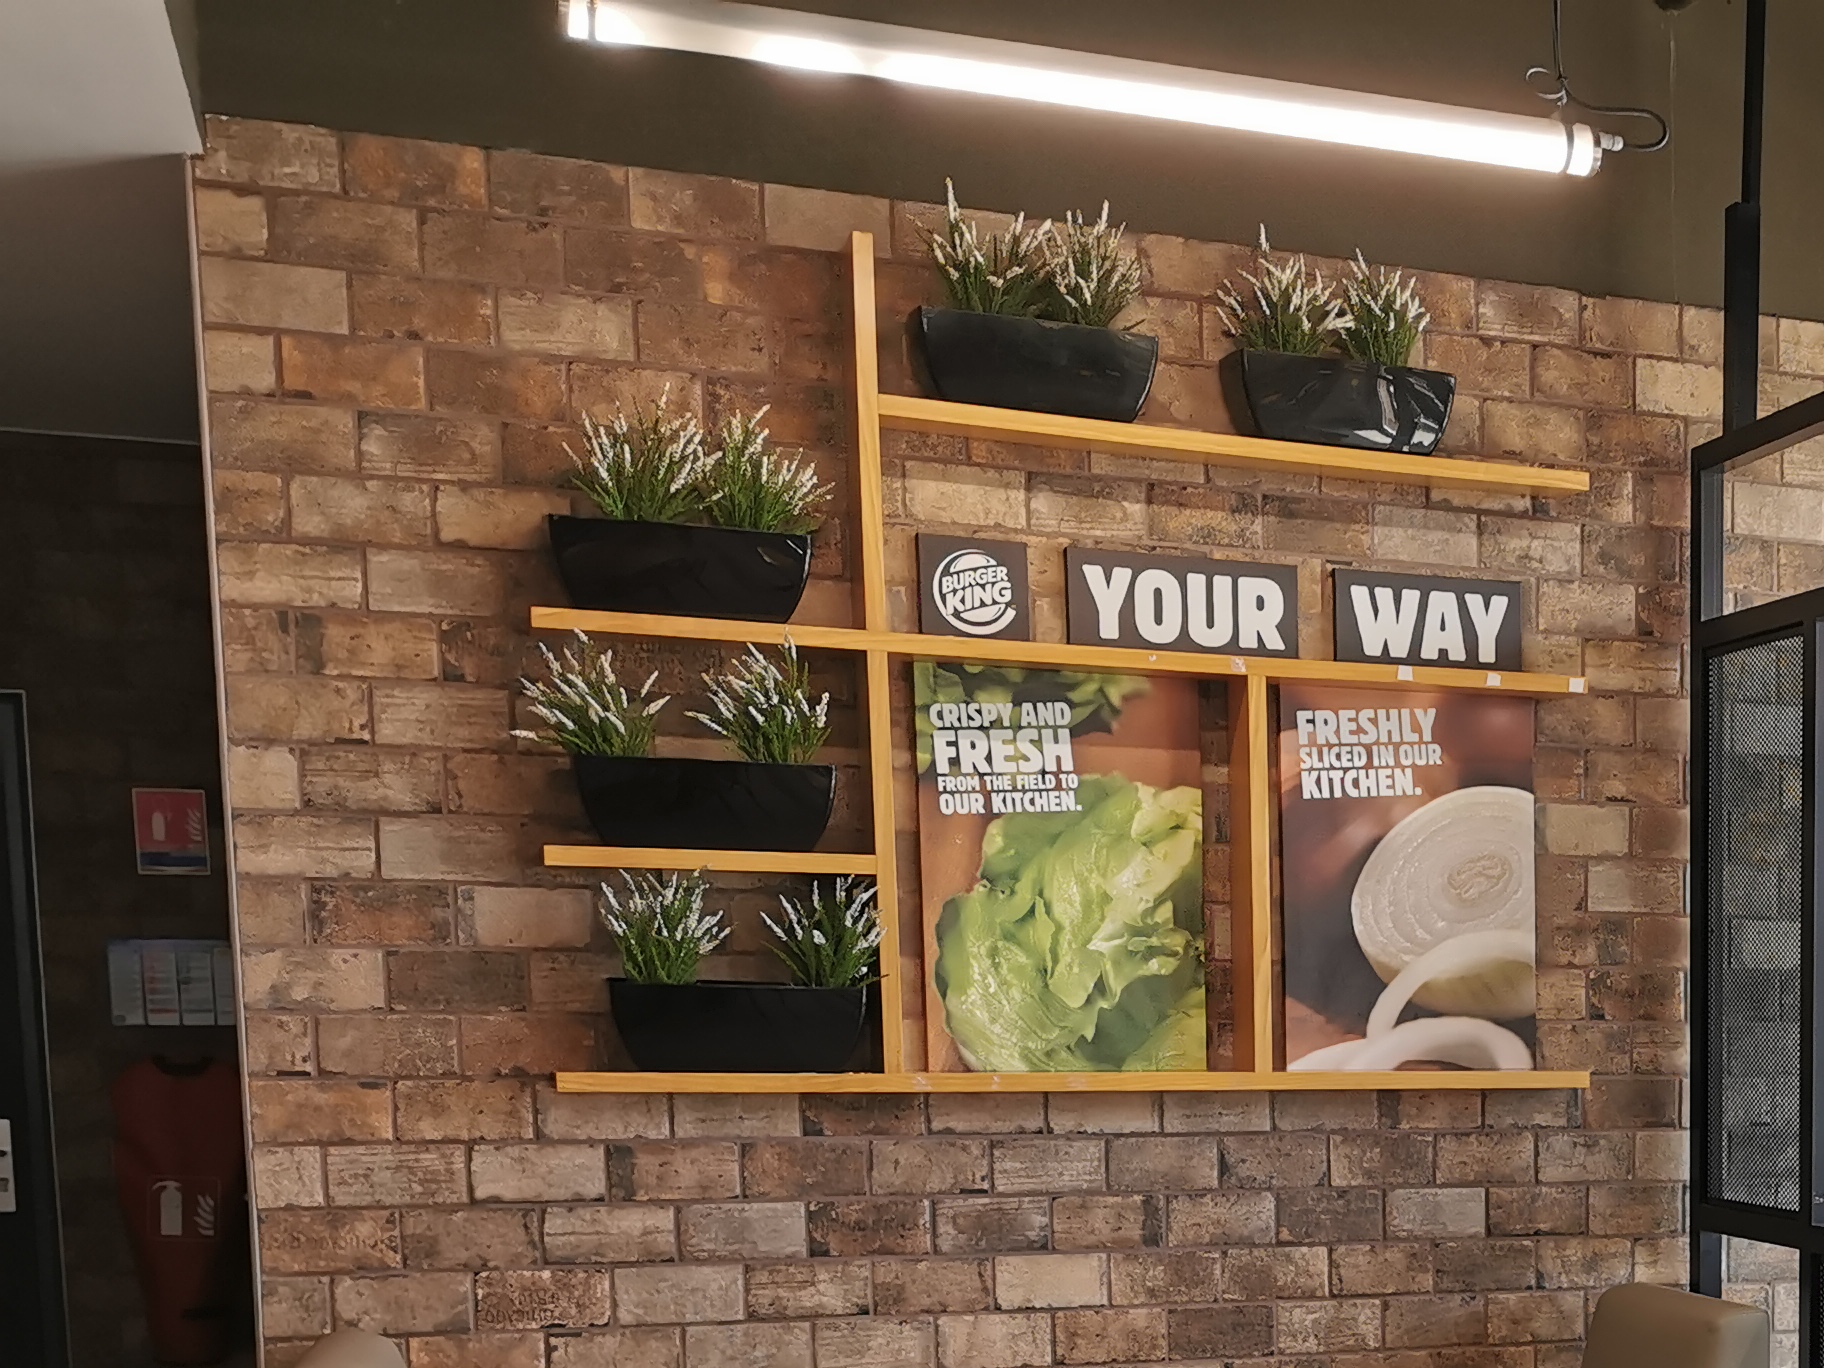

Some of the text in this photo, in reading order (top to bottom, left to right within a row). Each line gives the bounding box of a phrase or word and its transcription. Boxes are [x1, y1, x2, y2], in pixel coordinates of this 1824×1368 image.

[941, 566, 1008, 594] BURGER
[945, 581, 1012, 616] KING
[1081, 564, 1509, 664] YOUR WAY
[929, 702, 1072, 728] CRISPY AND
[1296, 708, 1437, 745] FRESHLY
[932, 728, 1075, 775] FRESH
[1299, 743, 1443, 769] SLICED IN OUR
[937, 773, 1079, 792] FROM THE FIELD TO
[1301, 767, 1423, 799] KITCHEN.
[939, 790, 1083, 815] OUR KITCHEN.
